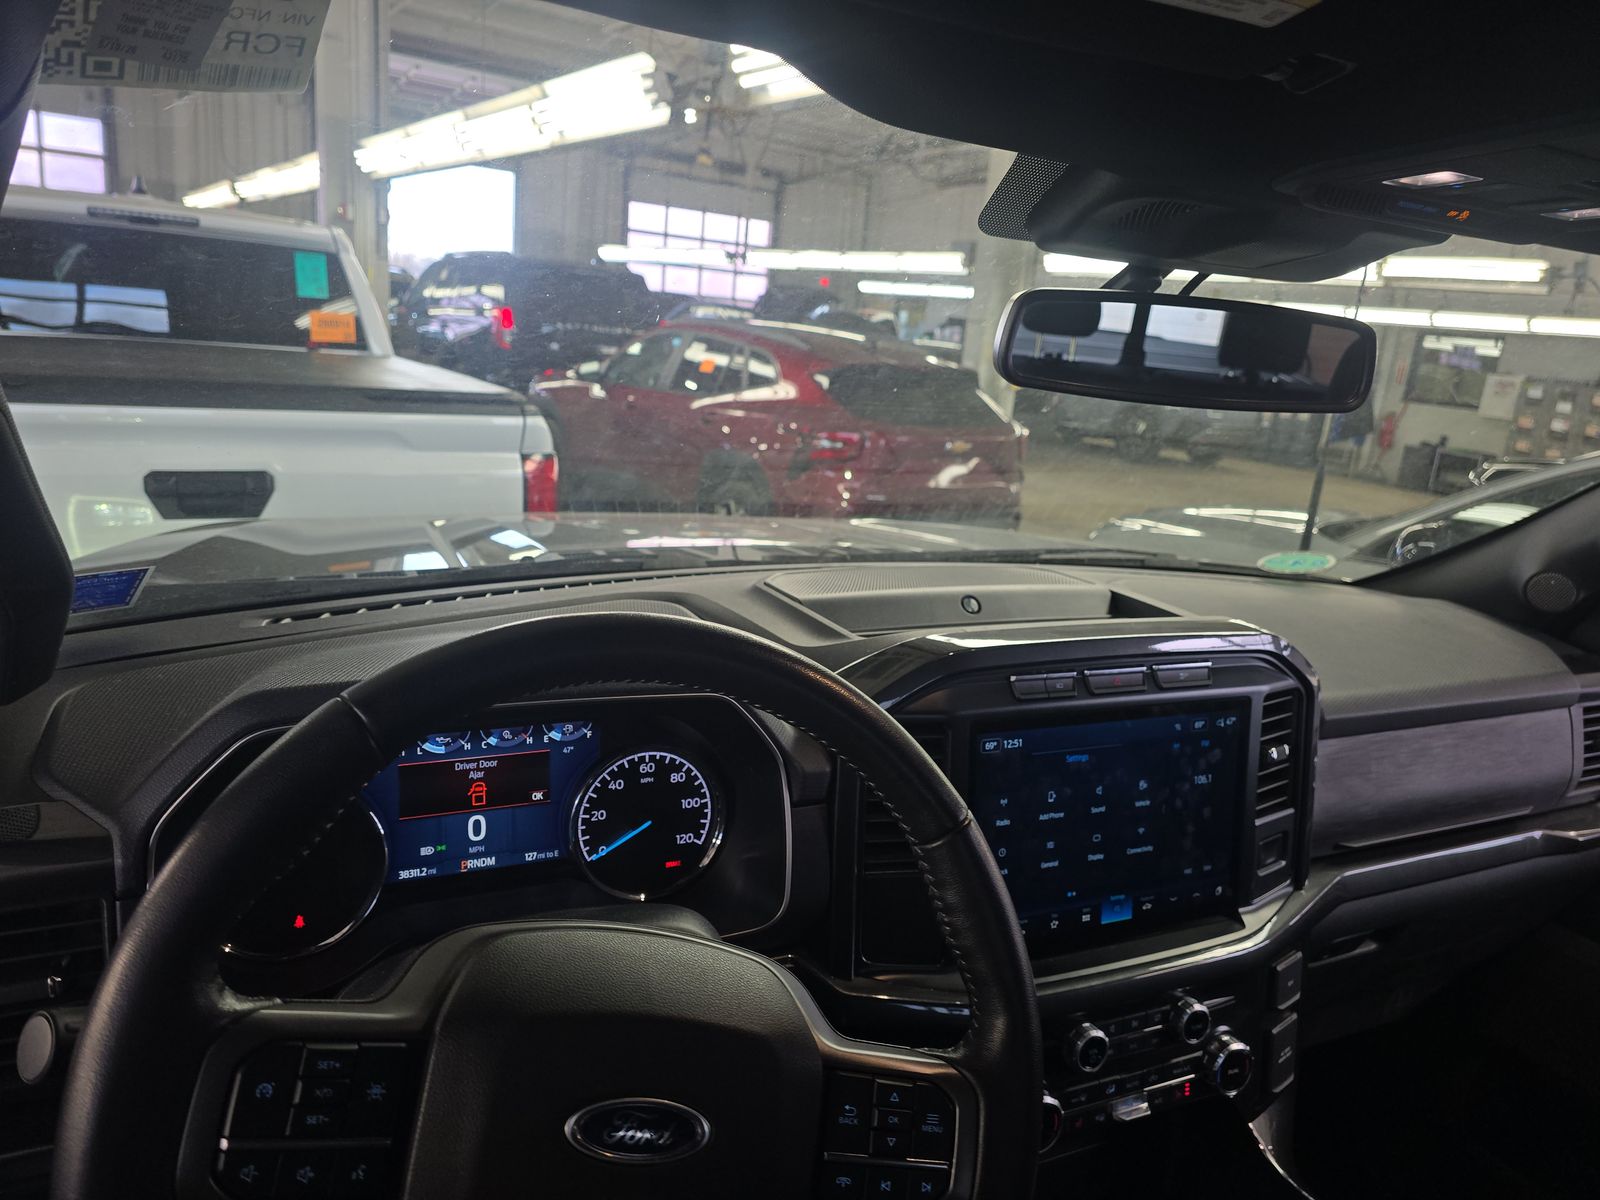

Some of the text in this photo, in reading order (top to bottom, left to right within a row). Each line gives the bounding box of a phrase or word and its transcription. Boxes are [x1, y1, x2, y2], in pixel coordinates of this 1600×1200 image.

[543, 735, 550, 743] E
[586, 730, 593, 739] F
[464, 742, 471, 751] H
[481, 740, 488, 749] C
[1003, 738, 1023, 749] 12:51
[416, 746, 423, 755] L
[455, 760, 498, 771] Driver Door
[639, 763, 656, 774] 60
[468, 770, 485, 780] Ajar
[670, 772, 686, 783] 80
[608, 780, 625, 790] 40
[532, 792, 544, 801] OK
[681, 798, 701, 809] 100
[591, 810, 607, 821] 20
[467, 814, 487, 842] 0
[676, 833, 694, 844] 120
[468, 845, 485, 854] MPH
[525, 852, 537, 862] 127
[838, 1116, 859, 1126] BACK
[921, 1124, 944, 1134] MENU
